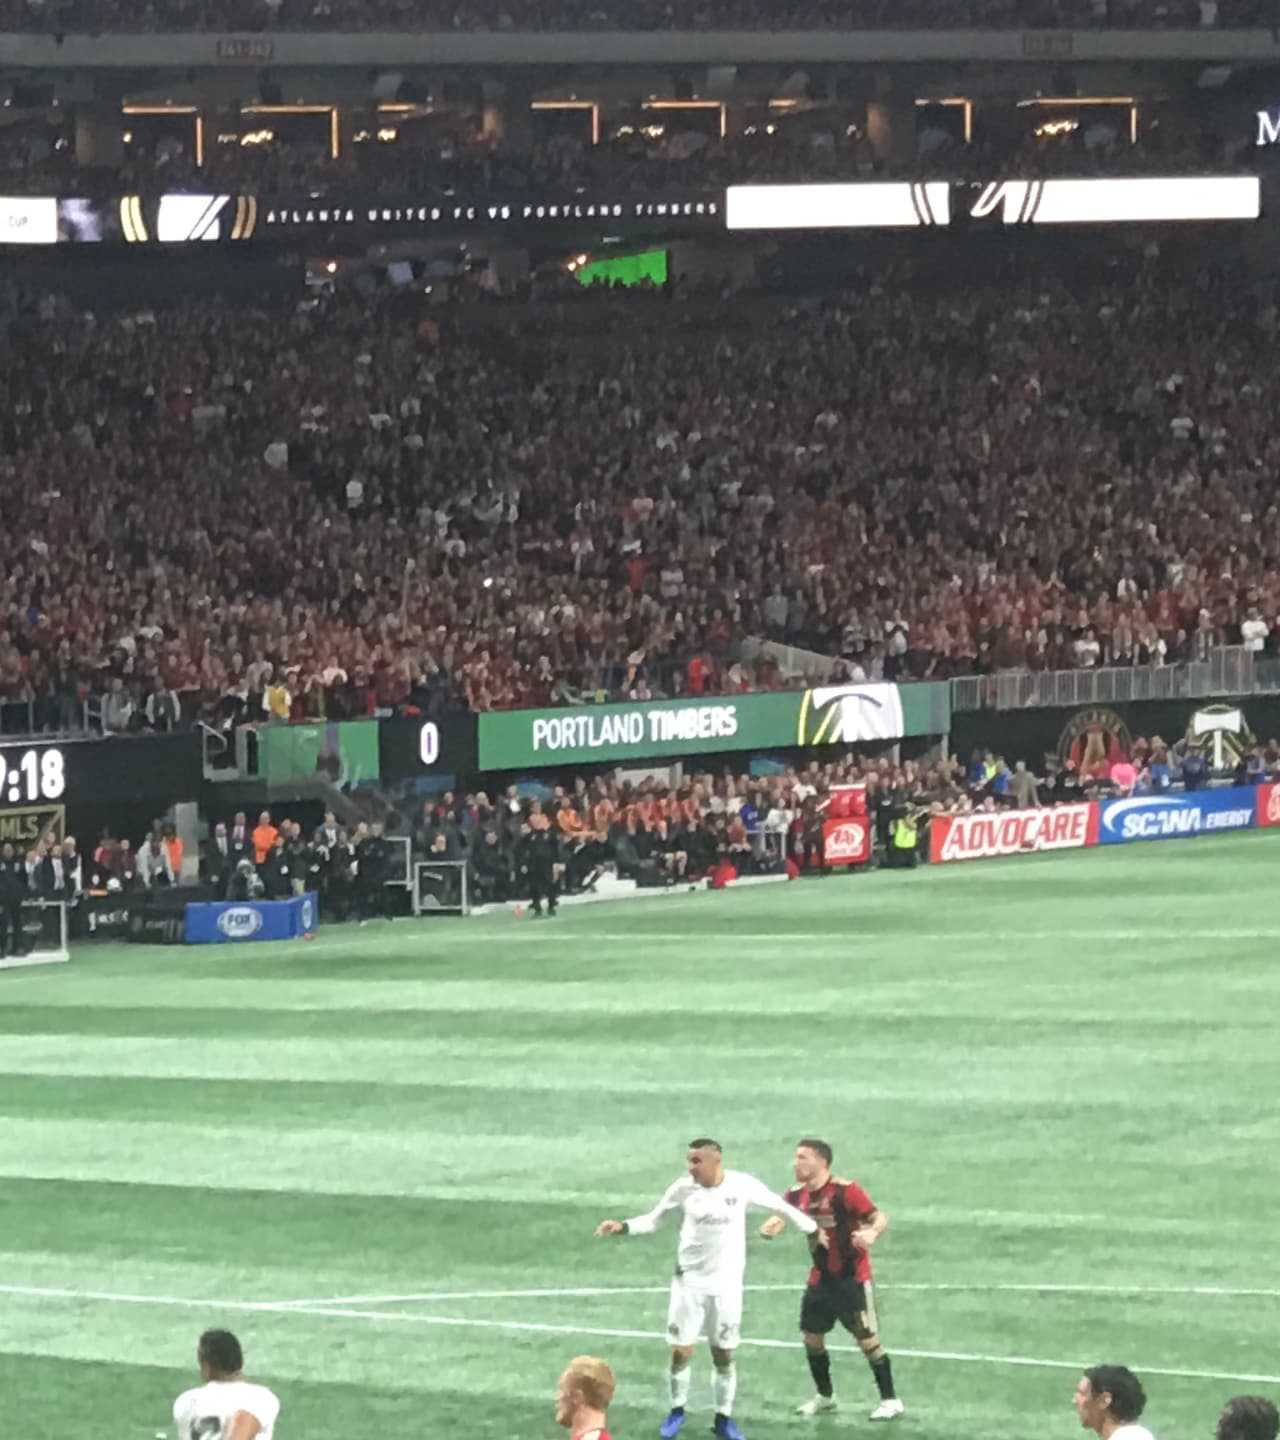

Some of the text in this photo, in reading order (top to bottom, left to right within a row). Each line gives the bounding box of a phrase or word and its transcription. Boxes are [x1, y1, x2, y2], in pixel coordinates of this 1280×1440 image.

[420, 722, 438, 764] 0
[532, 705, 738, 751] PORTLAND TIMBERS
[0, 816, 38, 841] MLS
[948, 811, 1085, 852] ADVOCARE
[1122, 808, 1254, 838] SCANA ENERGY
